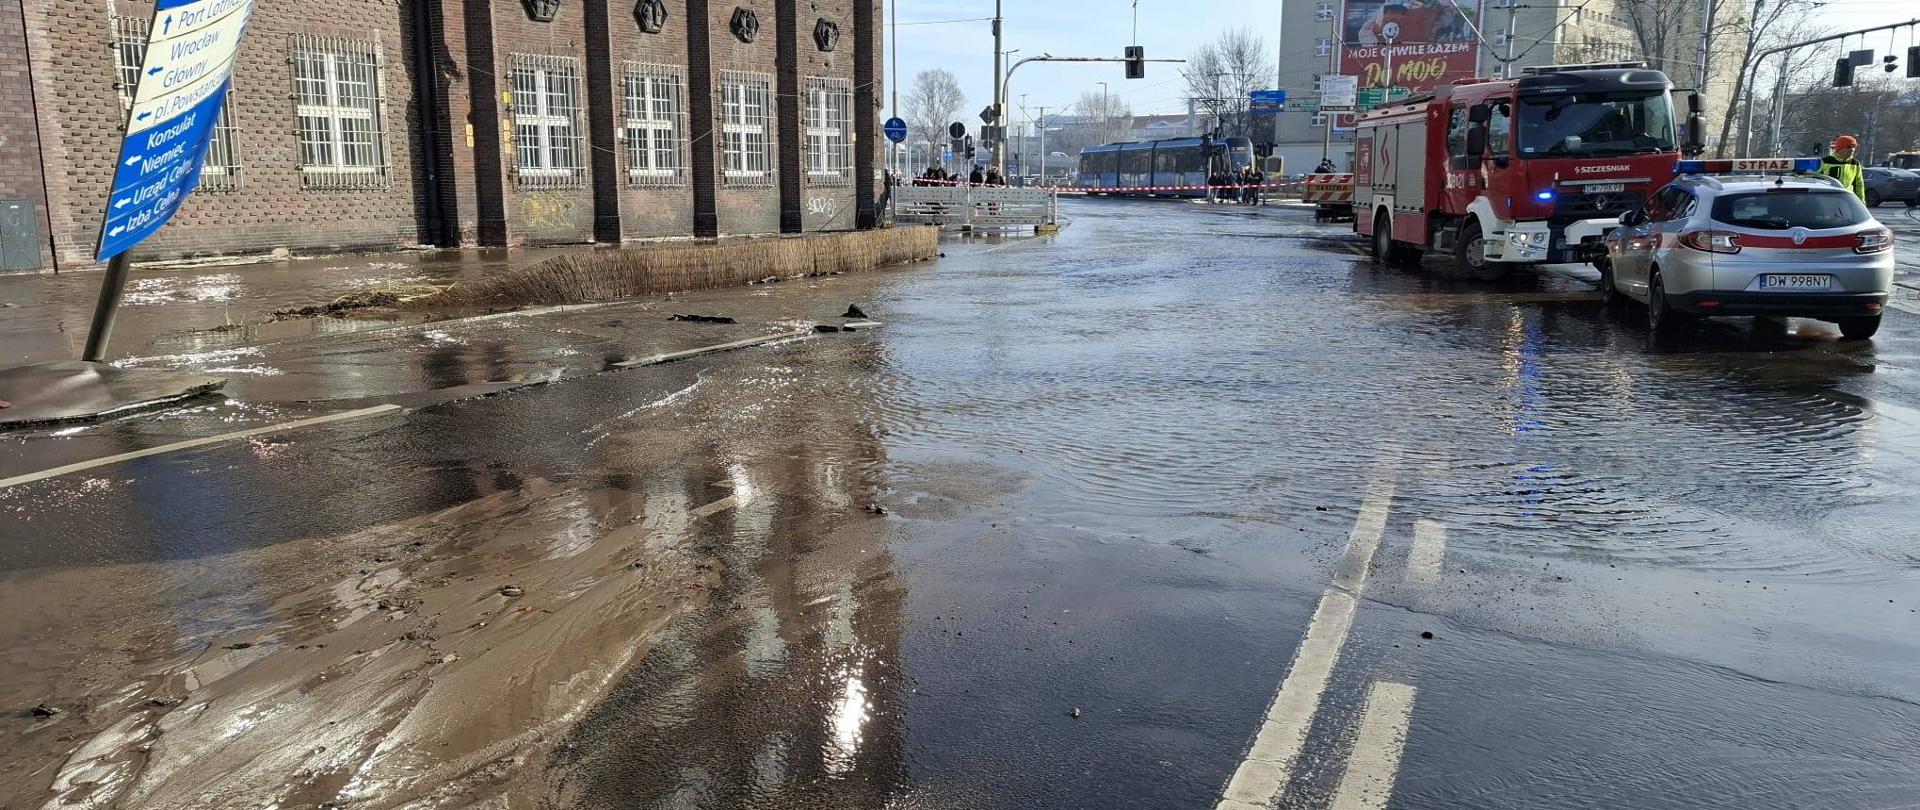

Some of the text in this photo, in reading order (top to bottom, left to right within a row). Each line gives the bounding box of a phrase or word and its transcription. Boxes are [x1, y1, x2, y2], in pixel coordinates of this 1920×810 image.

[178, 7, 204, 30] Port
[170, 30, 221, 61] Wrocław
[1348, 47, 1379, 59] MOJE
[1380, 44, 1425, 57] CHWILE
[146, 111, 196, 151] Konsulat
[139, 140, 187, 176] Niemiec
[133, 170, 169, 205] Urząd
[126, 207, 151, 233] Izba
[1768, 276, 1787, 287] DW
[1791, 276, 1829, 287] 998NY
